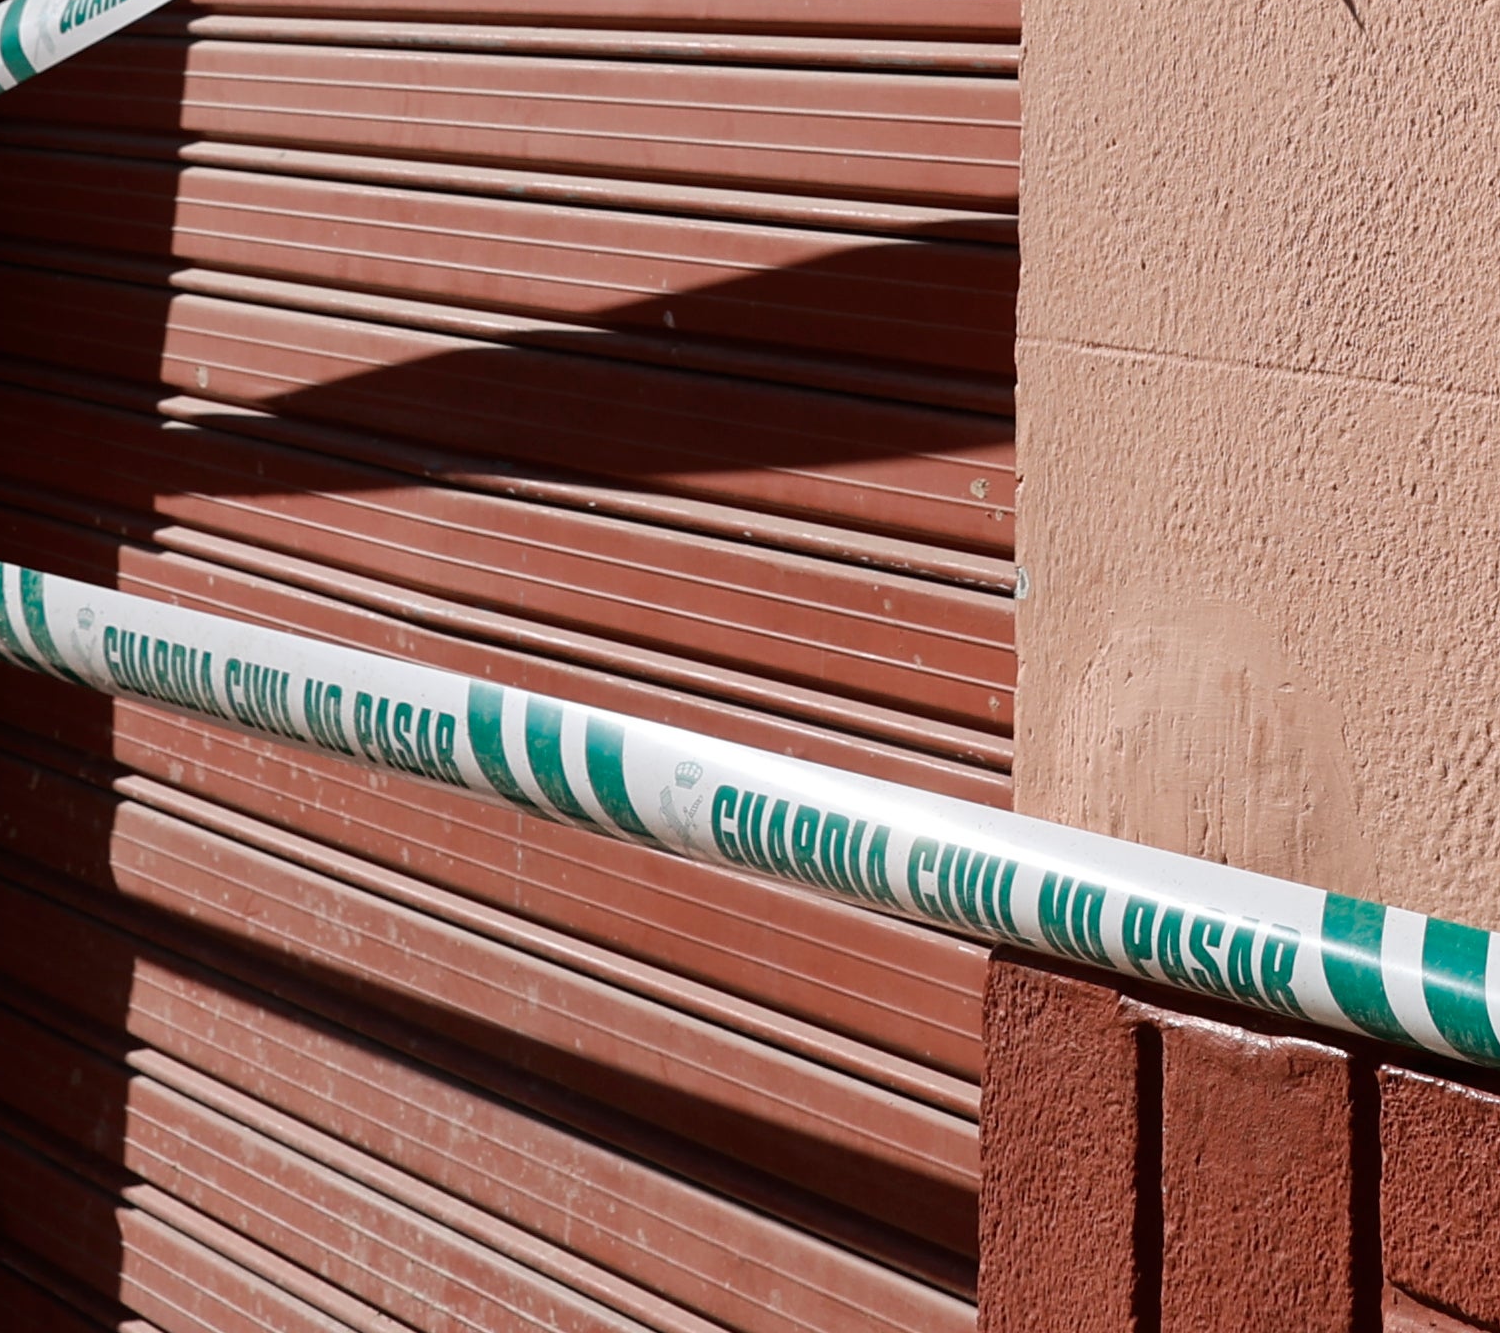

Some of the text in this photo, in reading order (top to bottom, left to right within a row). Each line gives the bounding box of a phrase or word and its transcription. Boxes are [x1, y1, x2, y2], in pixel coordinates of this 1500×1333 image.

[102, 624, 227, 719] GUARDIA
[224, 657, 306, 736] CIVIL
[302, 678, 356, 757] NO
[352, 689, 471, 785] PASAR
[711, 783, 901, 910] GUARDIA
[906, 835, 1028, 937] CIVIL
[1035, 871, 1116, 967] NO
[1121, 894, 1308, 1015] PASAR
